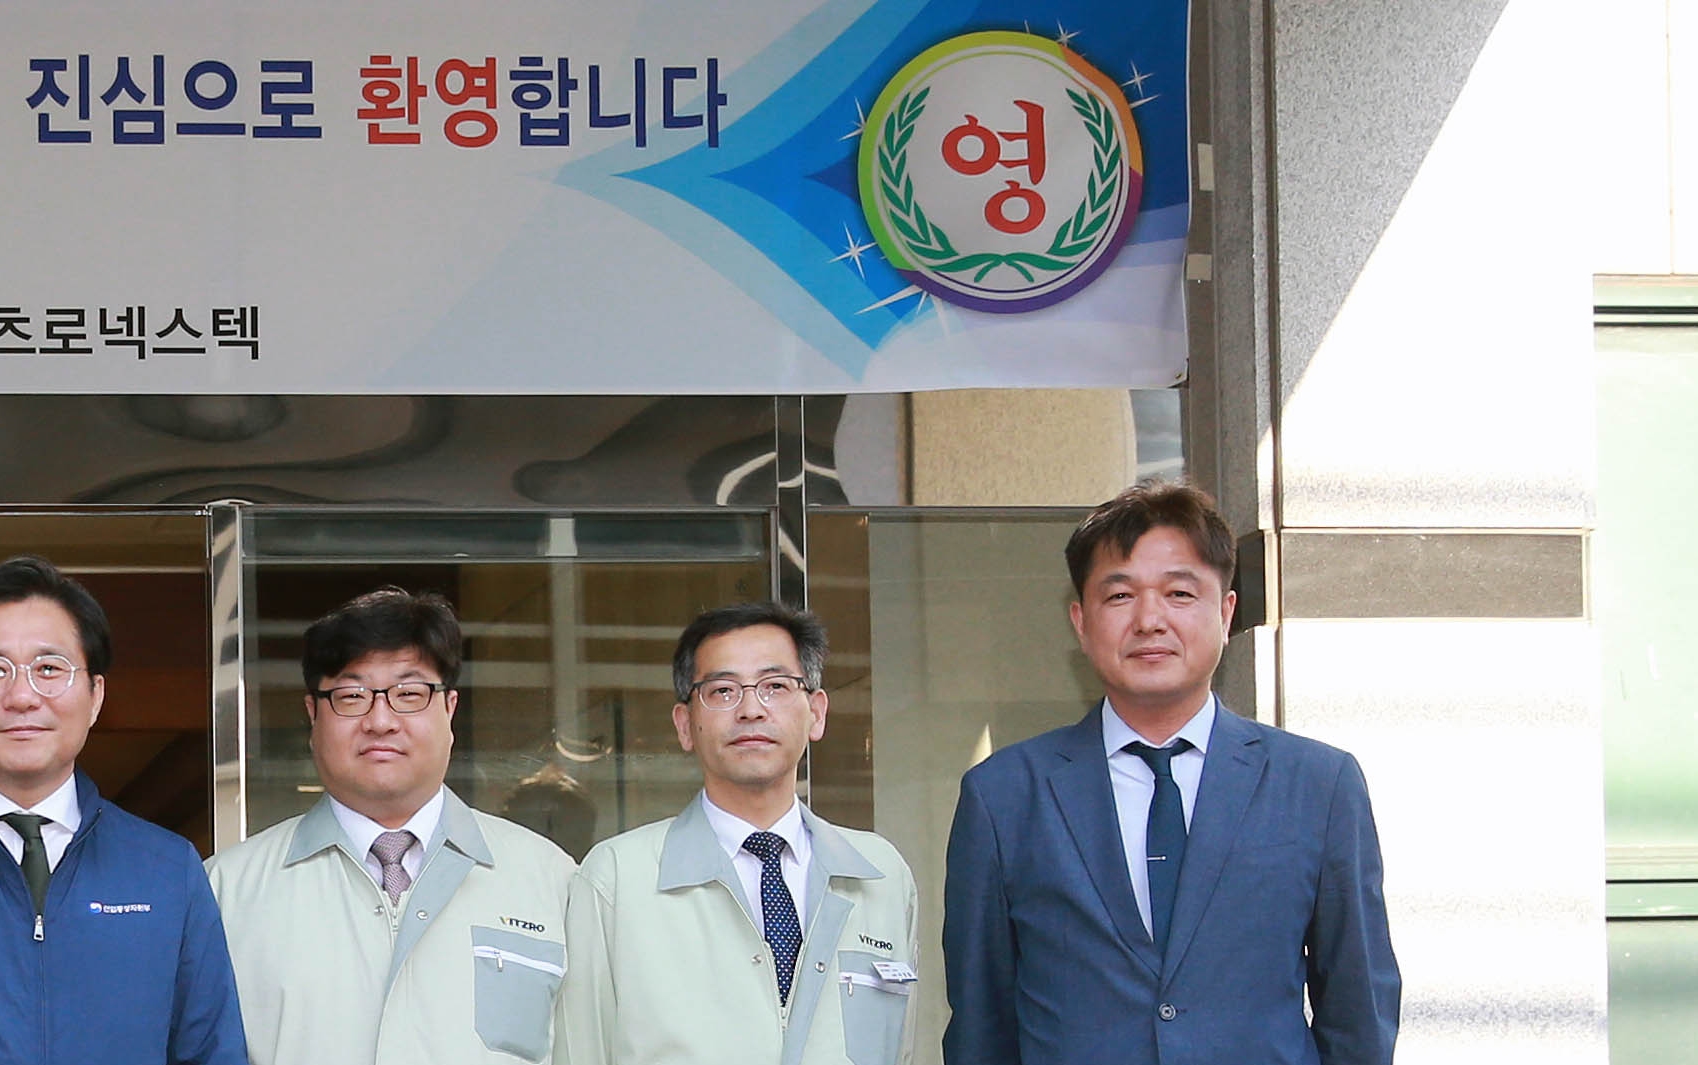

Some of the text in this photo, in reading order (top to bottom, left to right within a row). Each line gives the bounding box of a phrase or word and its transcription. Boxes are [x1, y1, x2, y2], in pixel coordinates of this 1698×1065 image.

[25, 53, 323, 146] 진심으로
[356, 55, 729, 150] 환영합니다
[941, 99, 1046, 234] 영
[499, 916, 545, 933] VITZRO
[858, 934, 893, 951] VITZRO
